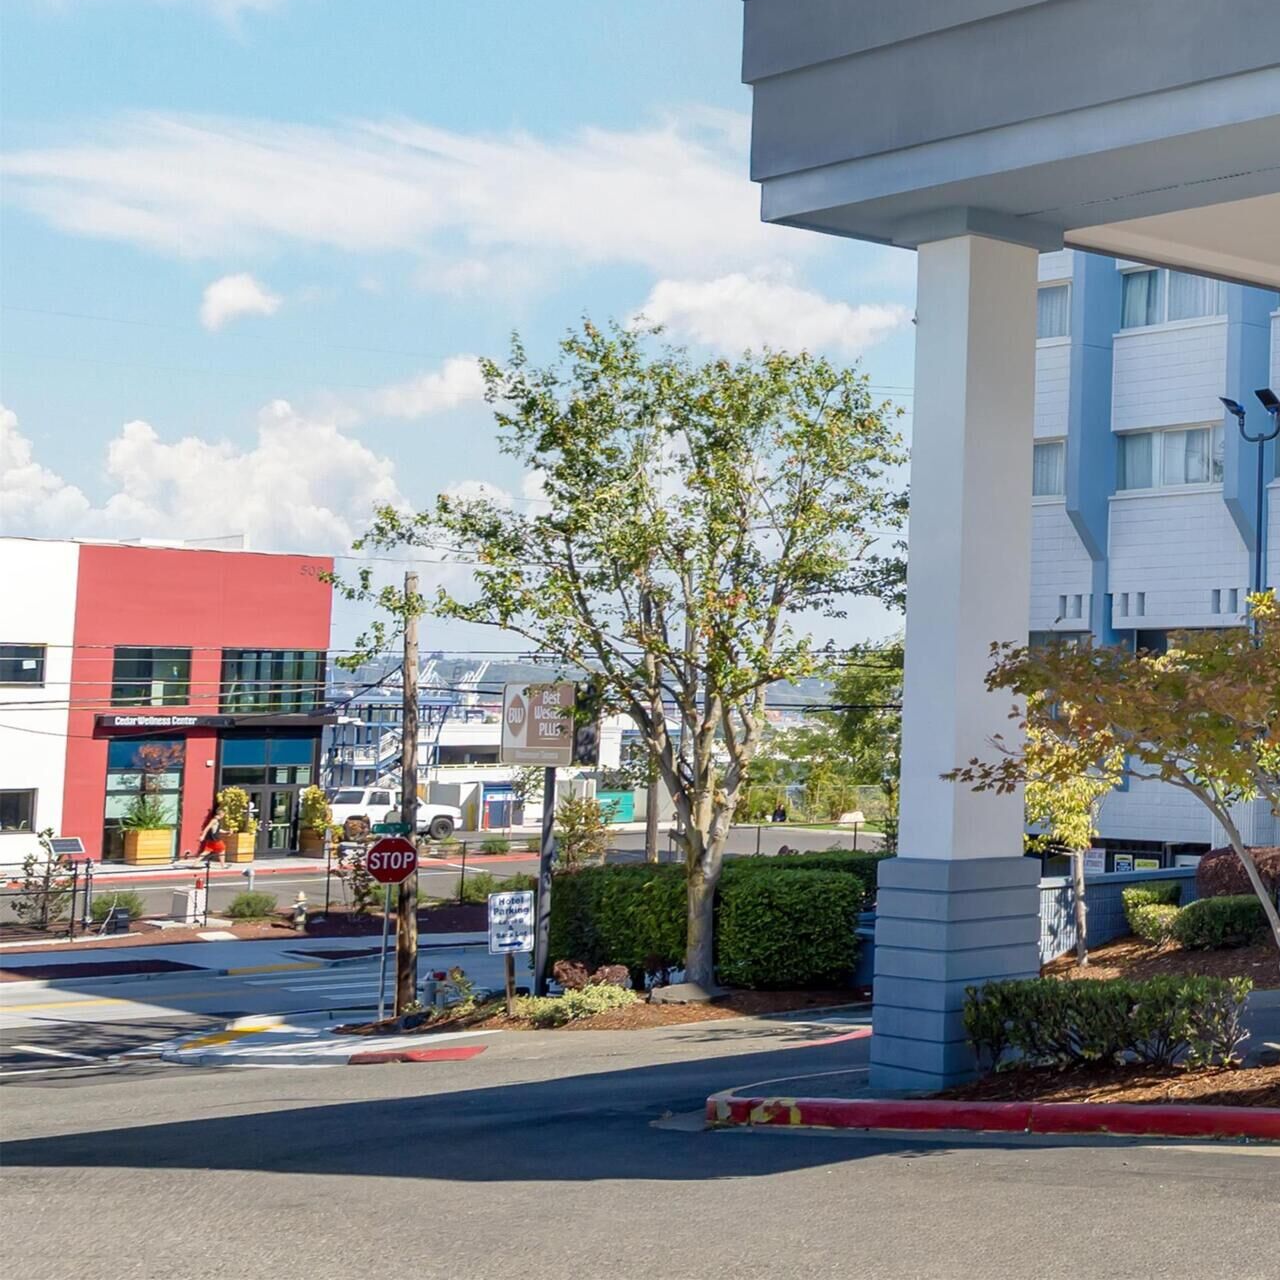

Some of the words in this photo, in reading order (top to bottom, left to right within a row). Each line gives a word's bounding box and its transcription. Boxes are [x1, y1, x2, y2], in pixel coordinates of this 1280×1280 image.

[543, 691, 561, 704] Best
[508, 708, 524, 723] BW
[539, 723, 562, 736] PLUS
[369, 852, 415, 870] STOP
[499, 896, 524, 905] Hotel
[493, 906, 530, 915] Parking
